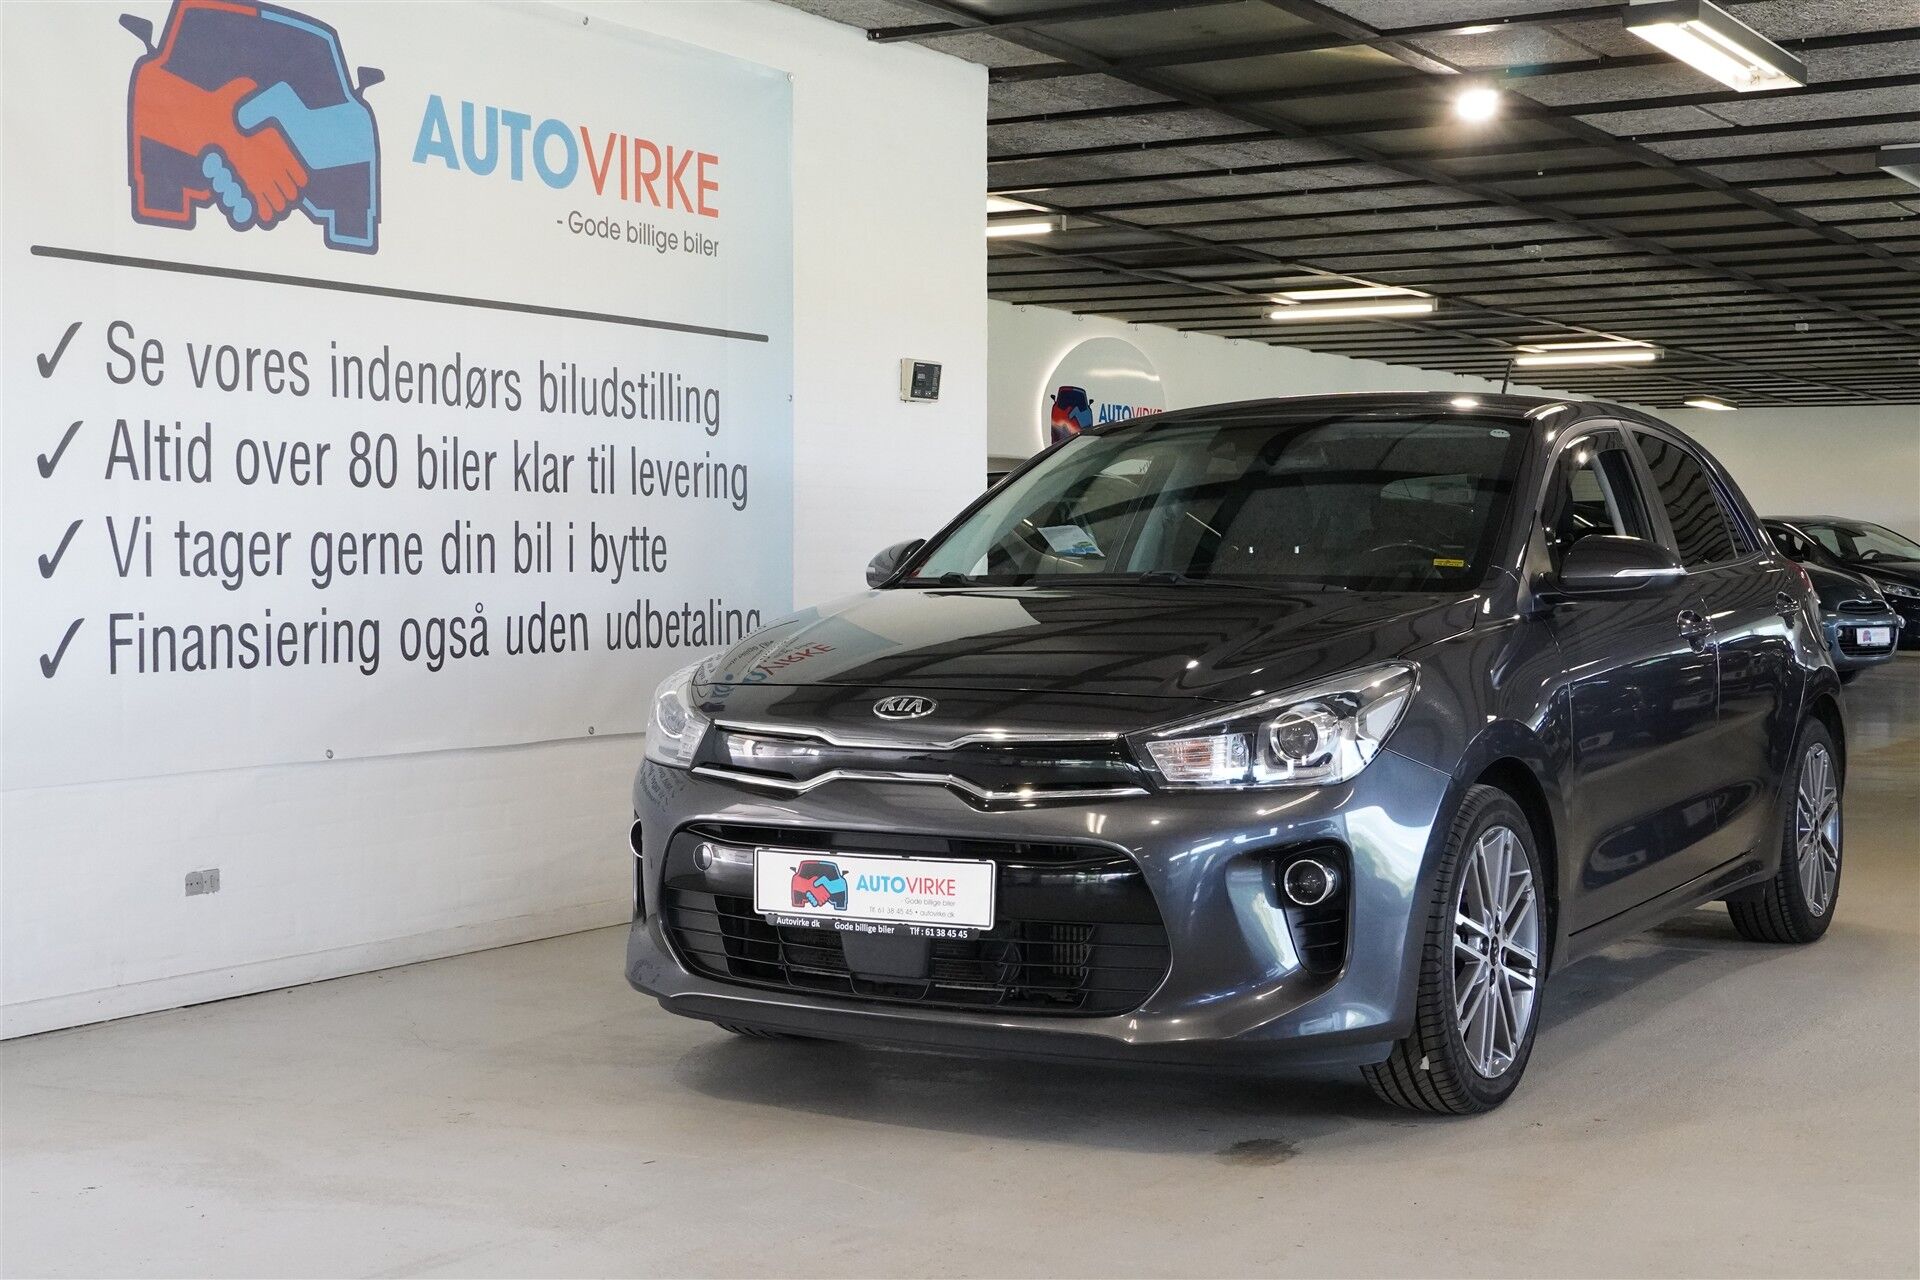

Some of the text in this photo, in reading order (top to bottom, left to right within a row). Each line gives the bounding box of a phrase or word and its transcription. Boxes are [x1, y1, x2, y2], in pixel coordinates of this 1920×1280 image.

[411, 93, 720, 218] AUTOVIRKE
[568, 210, 621, 241] Gode
[626, 220, 679, 254] billige
[683, 230, 719, 258] biler
[106, 320, 720, 437] Se vores indendørs biludstilling
[104, 418, 749, 512] Altid over 80 biler klar til levering
[105, 516, 668, 592] Vi tager gerne din bil i bytte
[109, 607, 382, 676] Finansiering
[400, 603, 490, 673] også
[506, 600, 589, 657] uden
[880, 697, 923, 713] KIA
[856, 874, 956, 896] AUTOVIRKE
[834, 921, 853, 930] Gode
[855, 922, 877, 934] billige
[878, 924, 895, 934] biler
[925, 928, 934, 936] 61
[936, 928, 946, 937] 38
[947, 929, 957, 938] 45
[958, 930, 968, 938] 45
